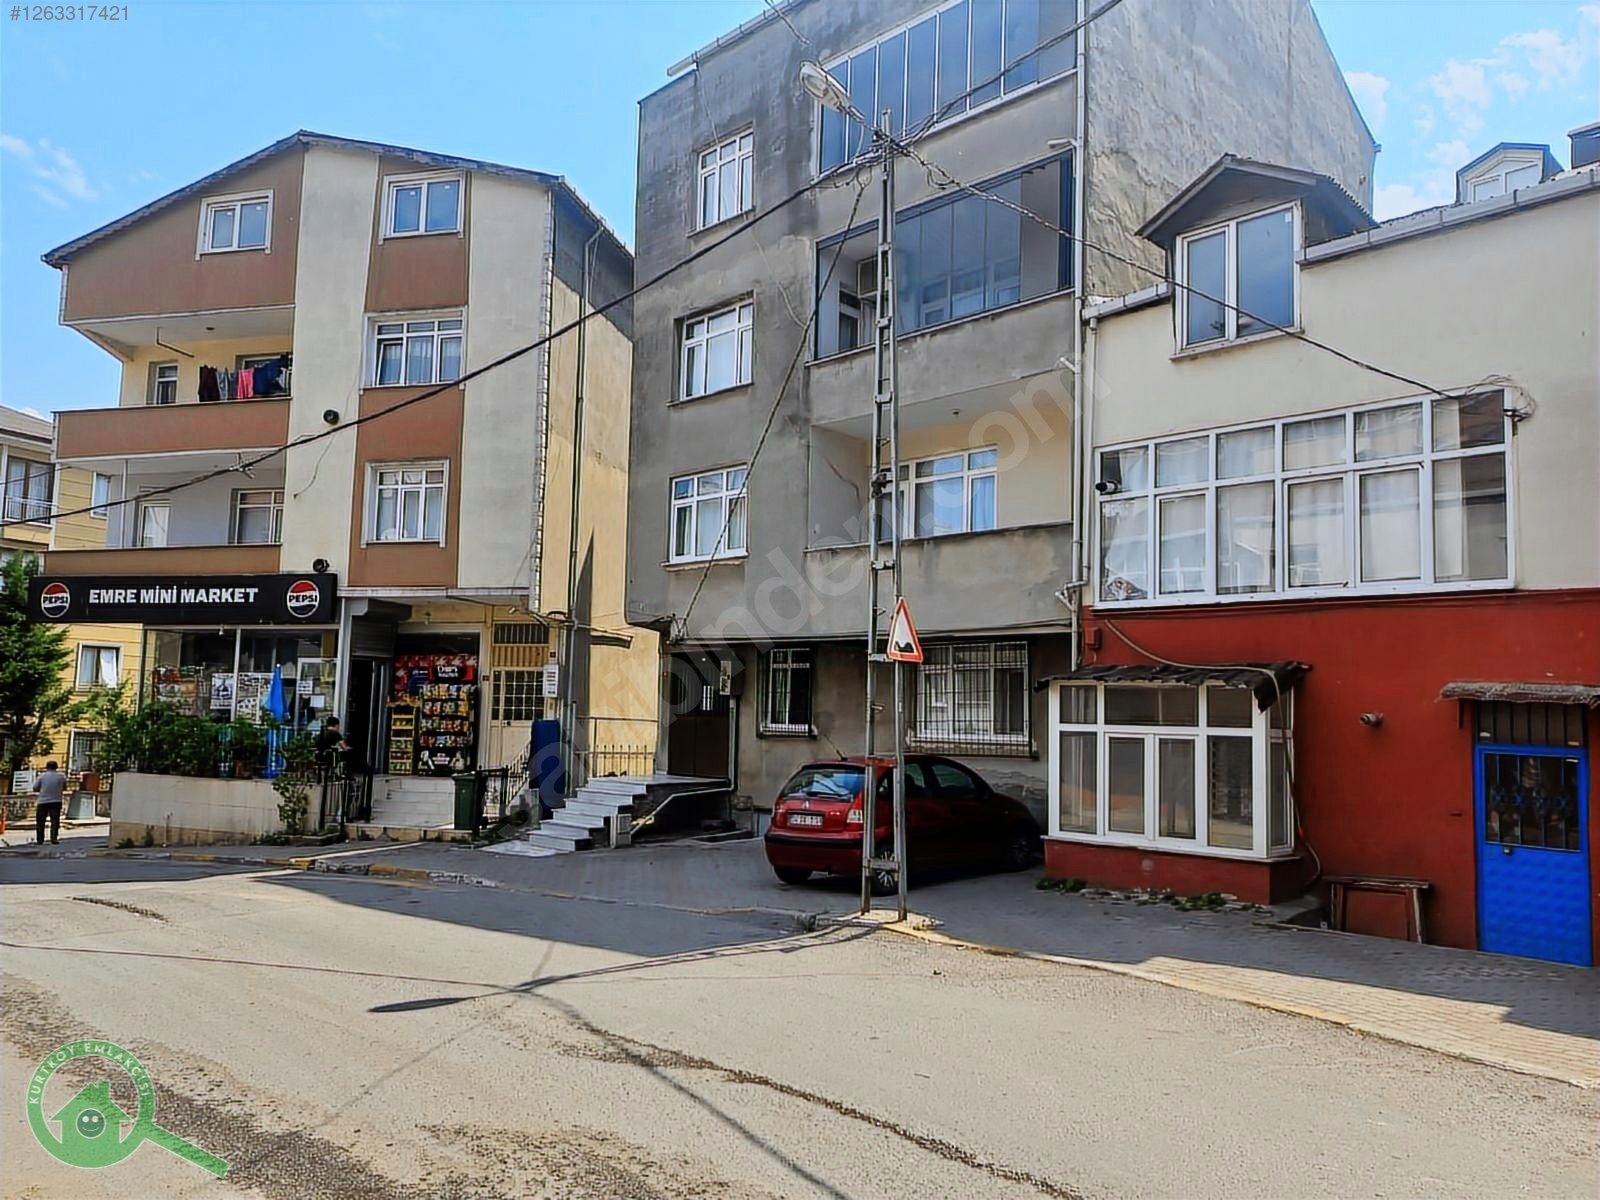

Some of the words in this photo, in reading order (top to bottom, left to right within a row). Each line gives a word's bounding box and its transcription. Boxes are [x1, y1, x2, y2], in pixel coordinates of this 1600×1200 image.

[89, 589, 137, 604] EMRE
[140, 585, 177, 604] MİNİ
[180, 587, 259, 603] MARKET
[289, 593, 318, 604] PEPSI
[43, 595, 69, 606] PEPSI
